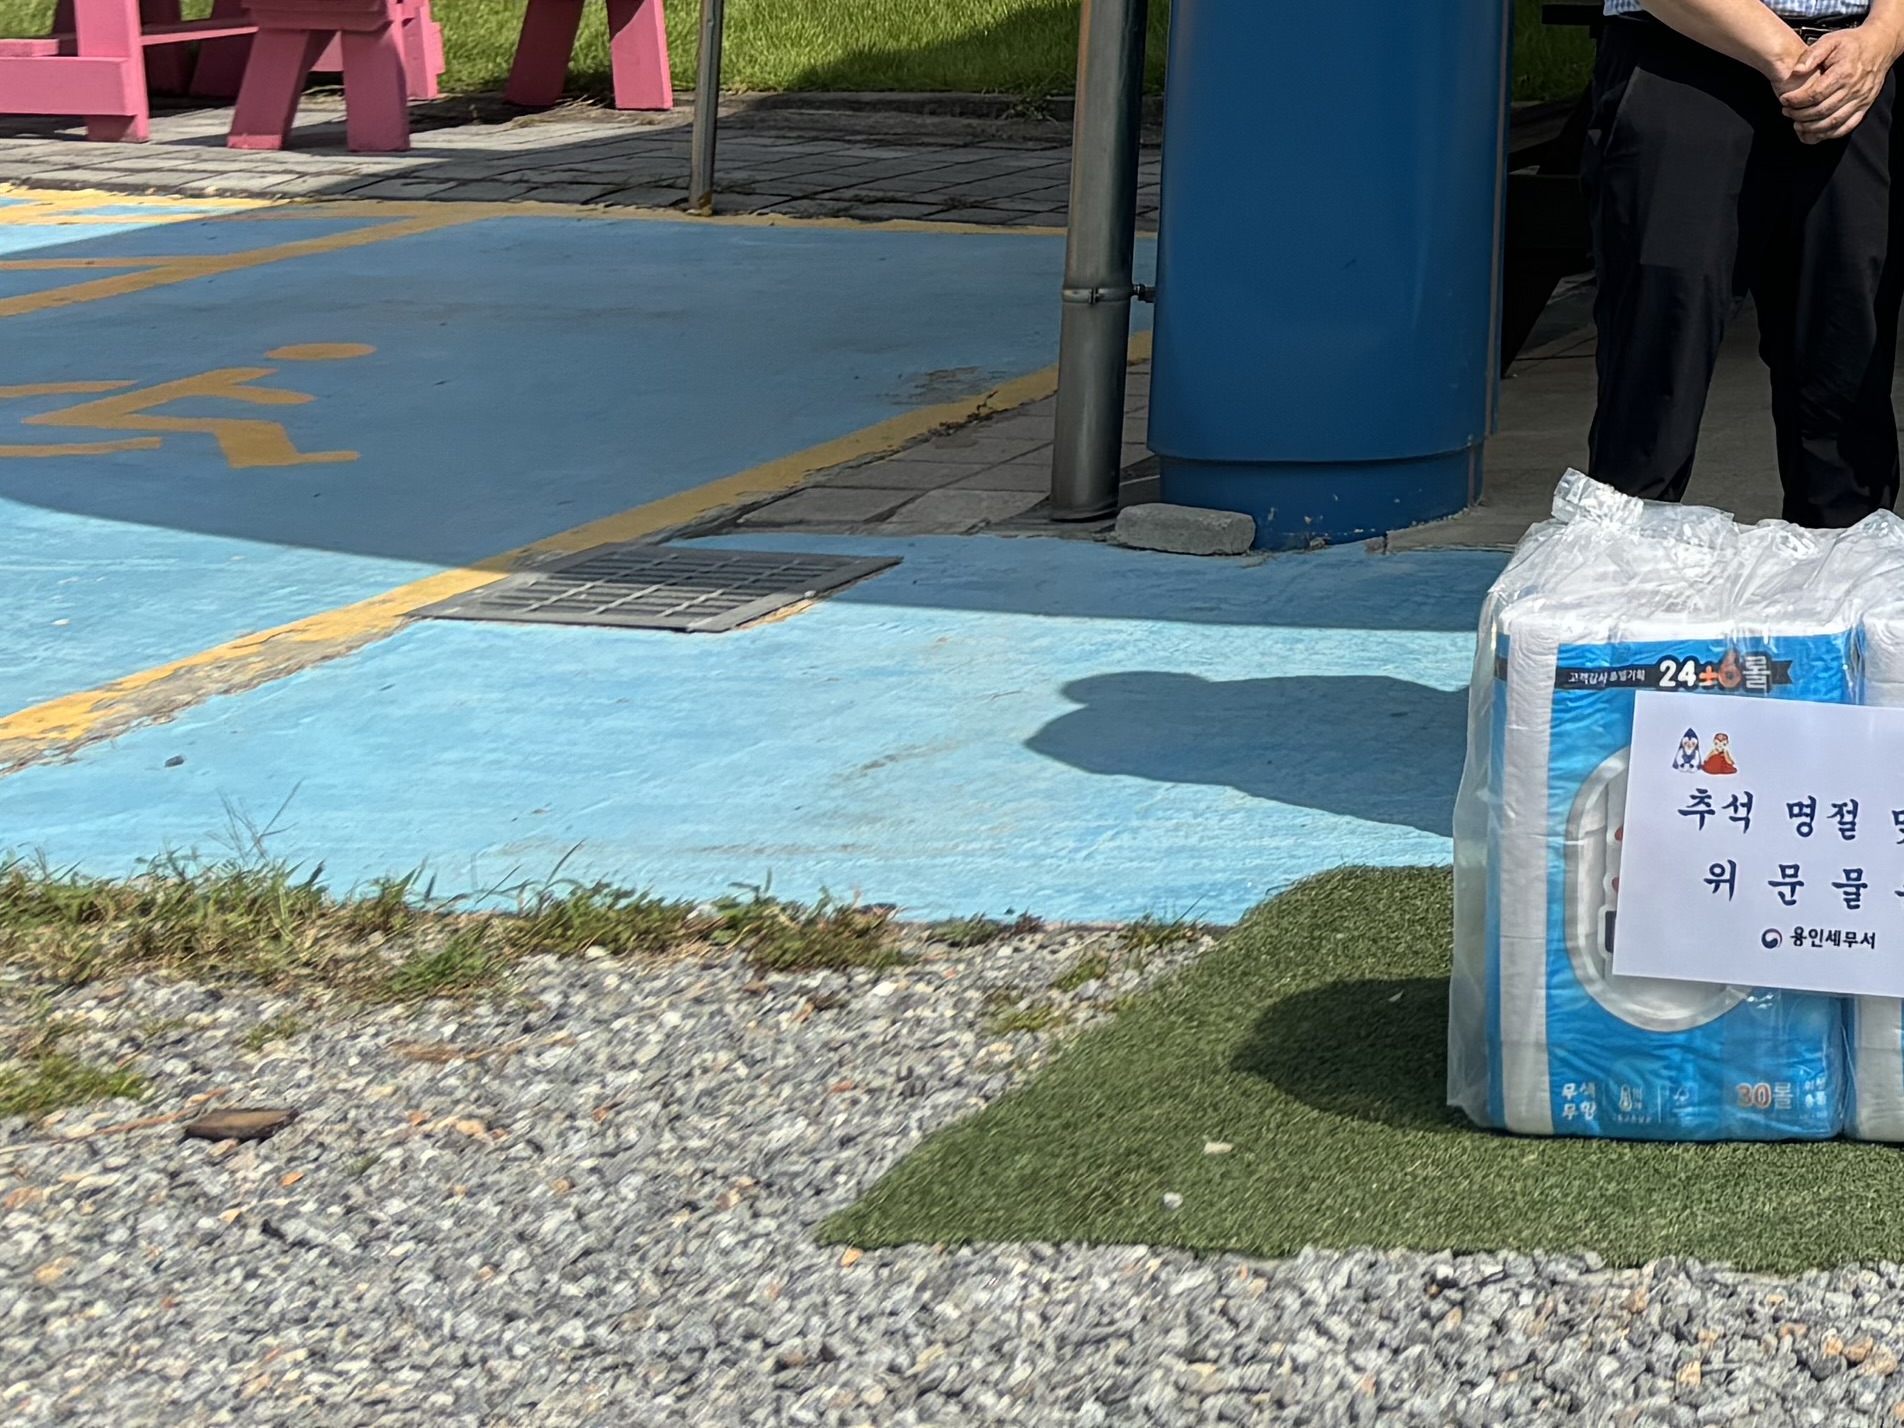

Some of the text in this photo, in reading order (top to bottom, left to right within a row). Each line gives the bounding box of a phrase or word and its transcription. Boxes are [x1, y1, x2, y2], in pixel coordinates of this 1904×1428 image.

[1677, 787, 1754, 834] 추석
[1786, 795, 1859, 841] 명절
[1789, 926, 1876, 950] 용인세무서
